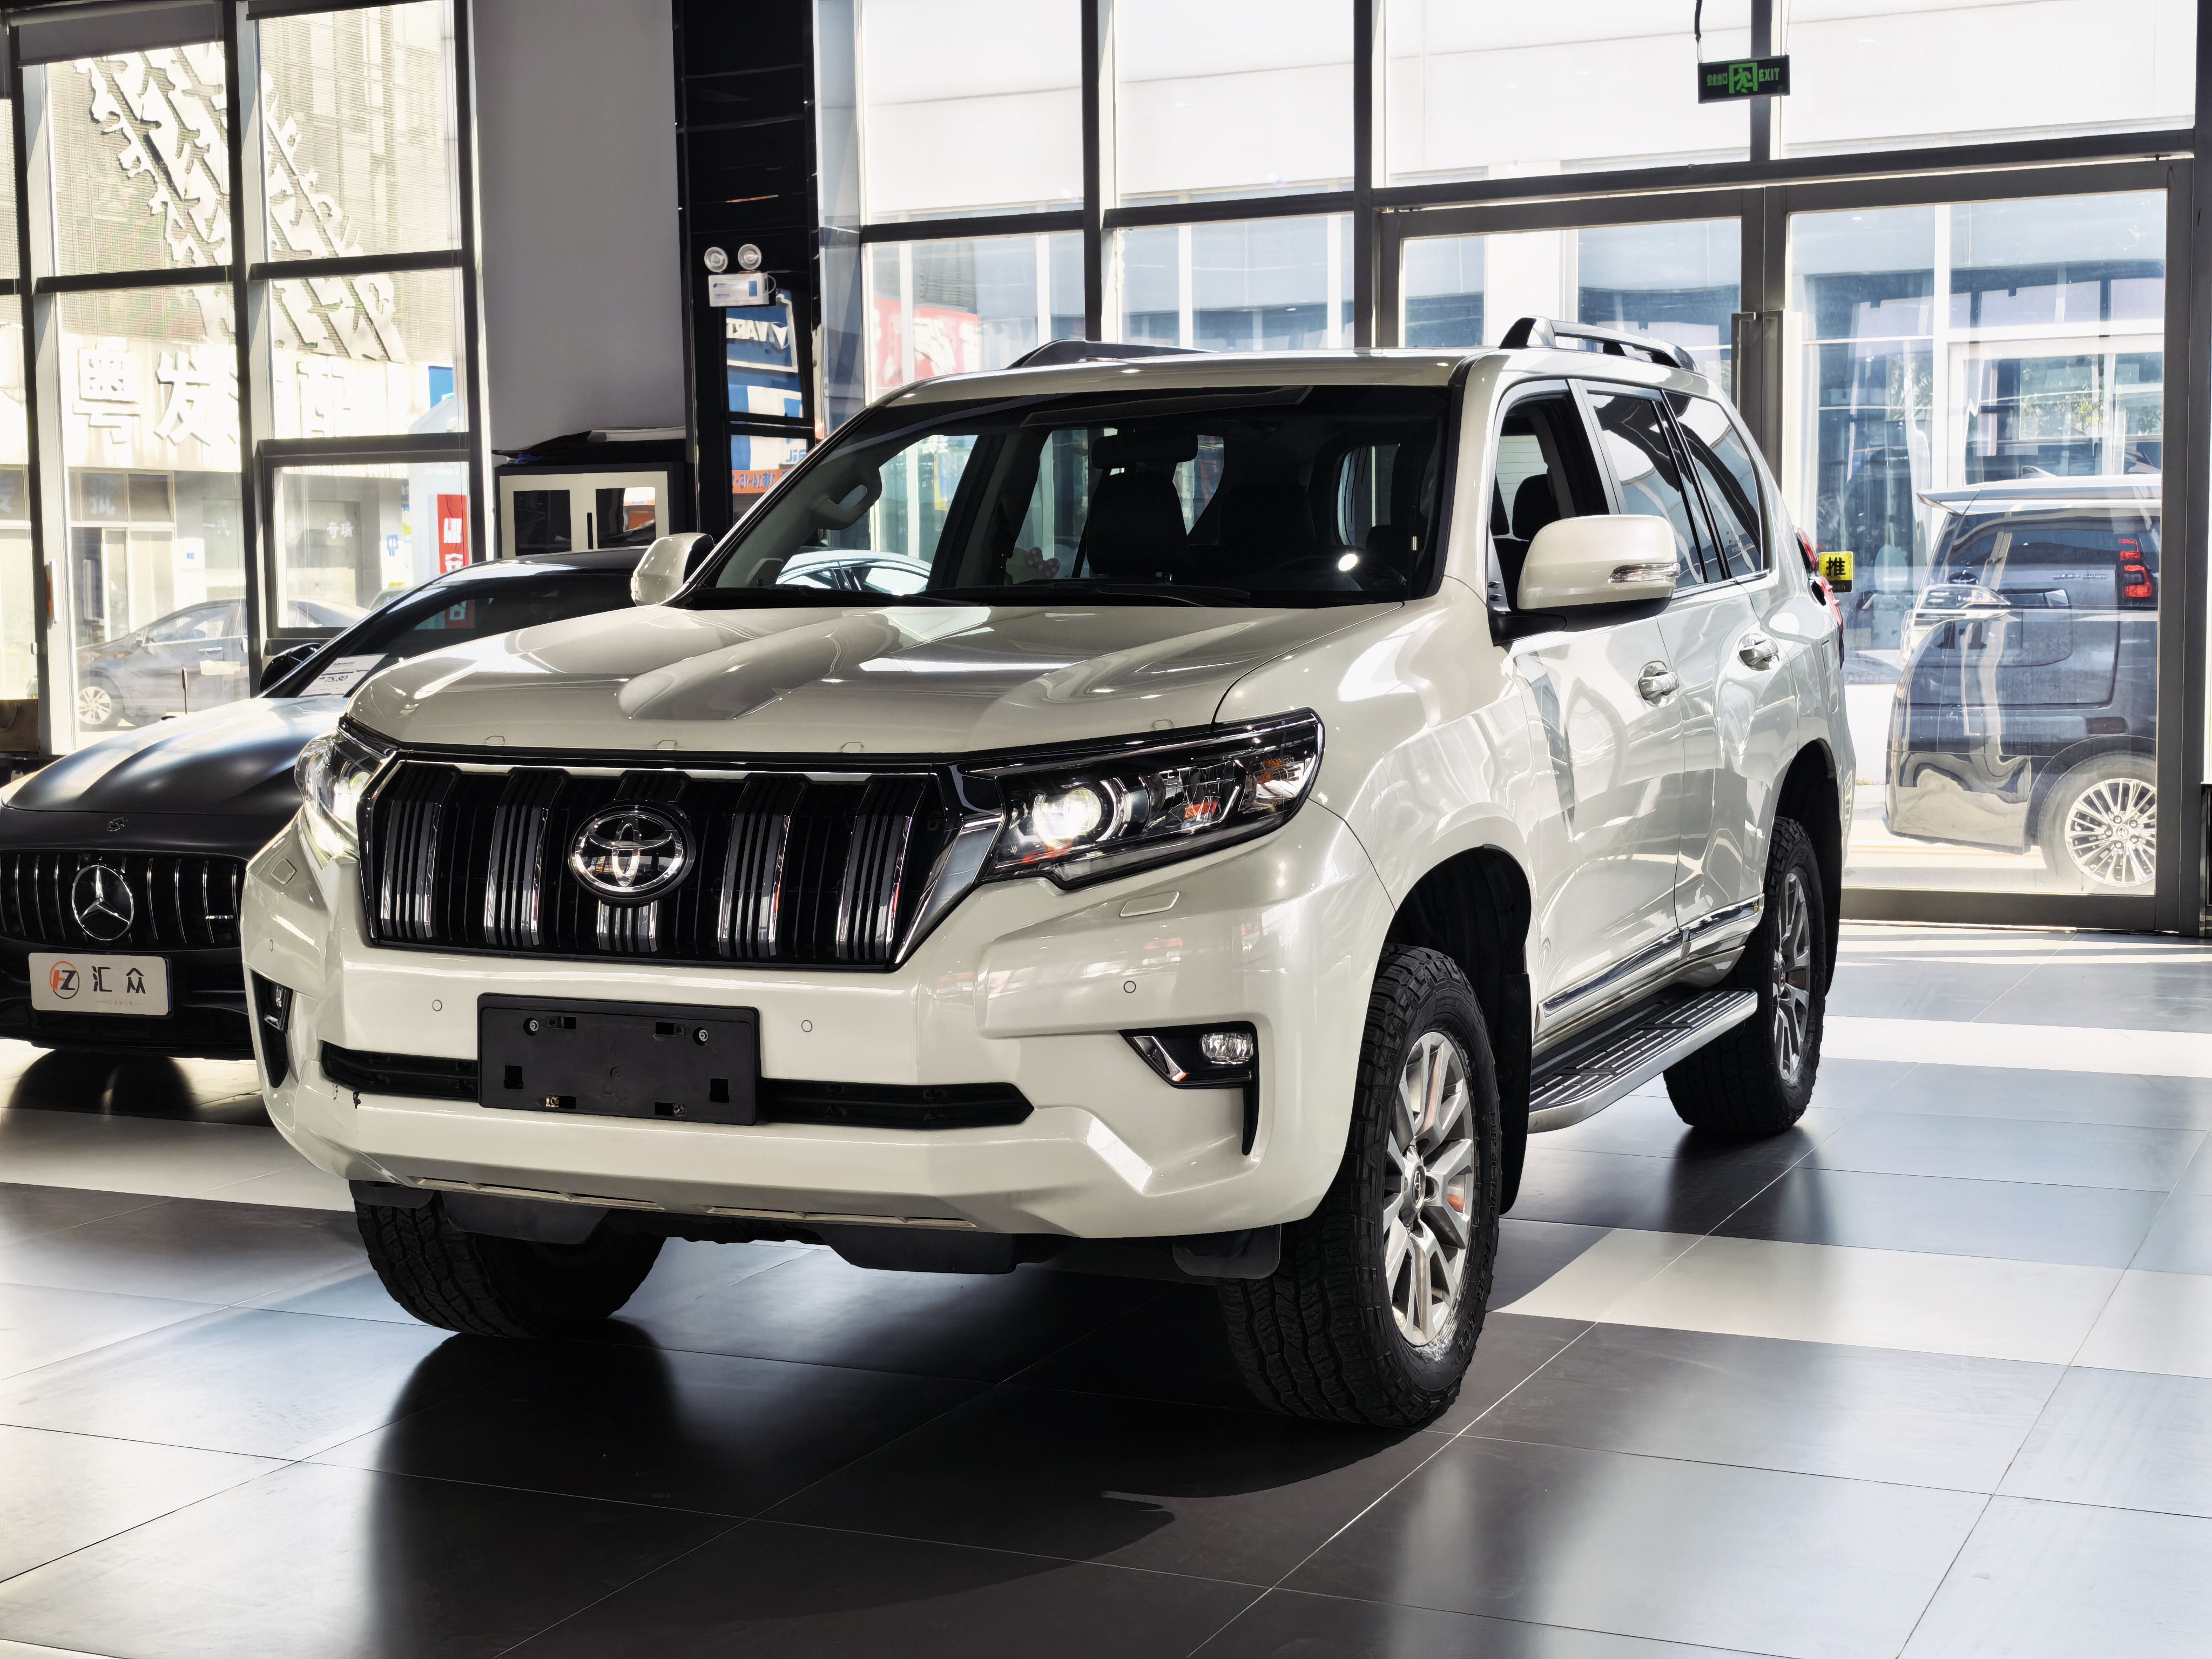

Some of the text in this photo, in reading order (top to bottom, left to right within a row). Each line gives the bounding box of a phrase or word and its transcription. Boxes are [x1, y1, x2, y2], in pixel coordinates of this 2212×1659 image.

[1759, 68, 1779, 82] EXIT
[1826, 557, 1846, 576] 推
[92, 966, 146, 994] 汇众
